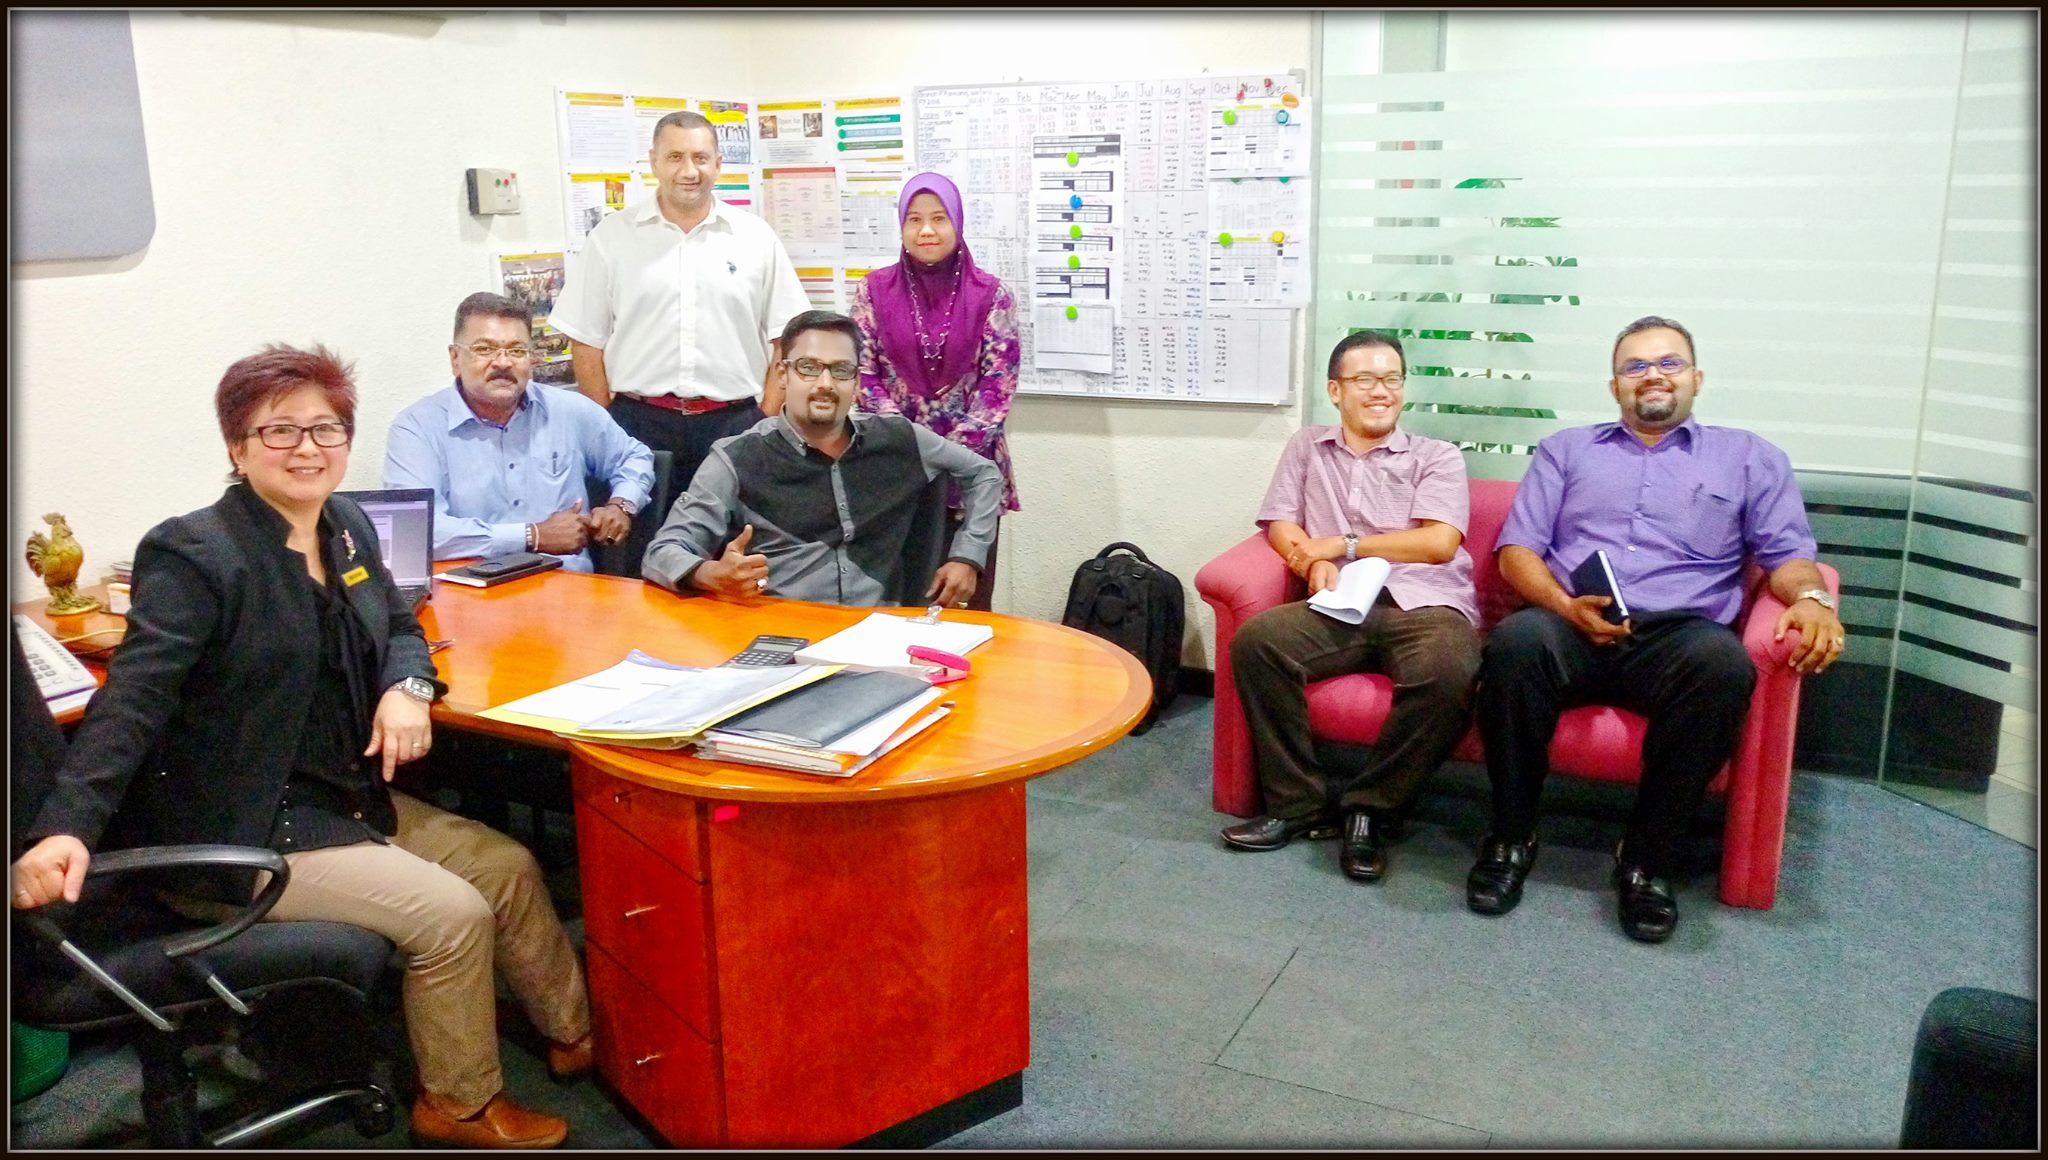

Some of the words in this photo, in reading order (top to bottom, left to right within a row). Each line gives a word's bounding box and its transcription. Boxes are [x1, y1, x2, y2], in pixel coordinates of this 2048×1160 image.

[994, 92, 1009, 104] Jan
[1017, 90, 1032, 102] Feb
[1040, 92, 1057, 102] Mar
[1087, 90, 1107, 104] May
[1112, 84, 1130, 99] Jun
[1137, 82, 1154, 98] Jul
[1164, 84, 1182, 99] Aug
[1189, 83, 1206, 98] Sept
[1215, 82, 1231, 94] Oct
[1242, 83, 1260, 95] Nov
